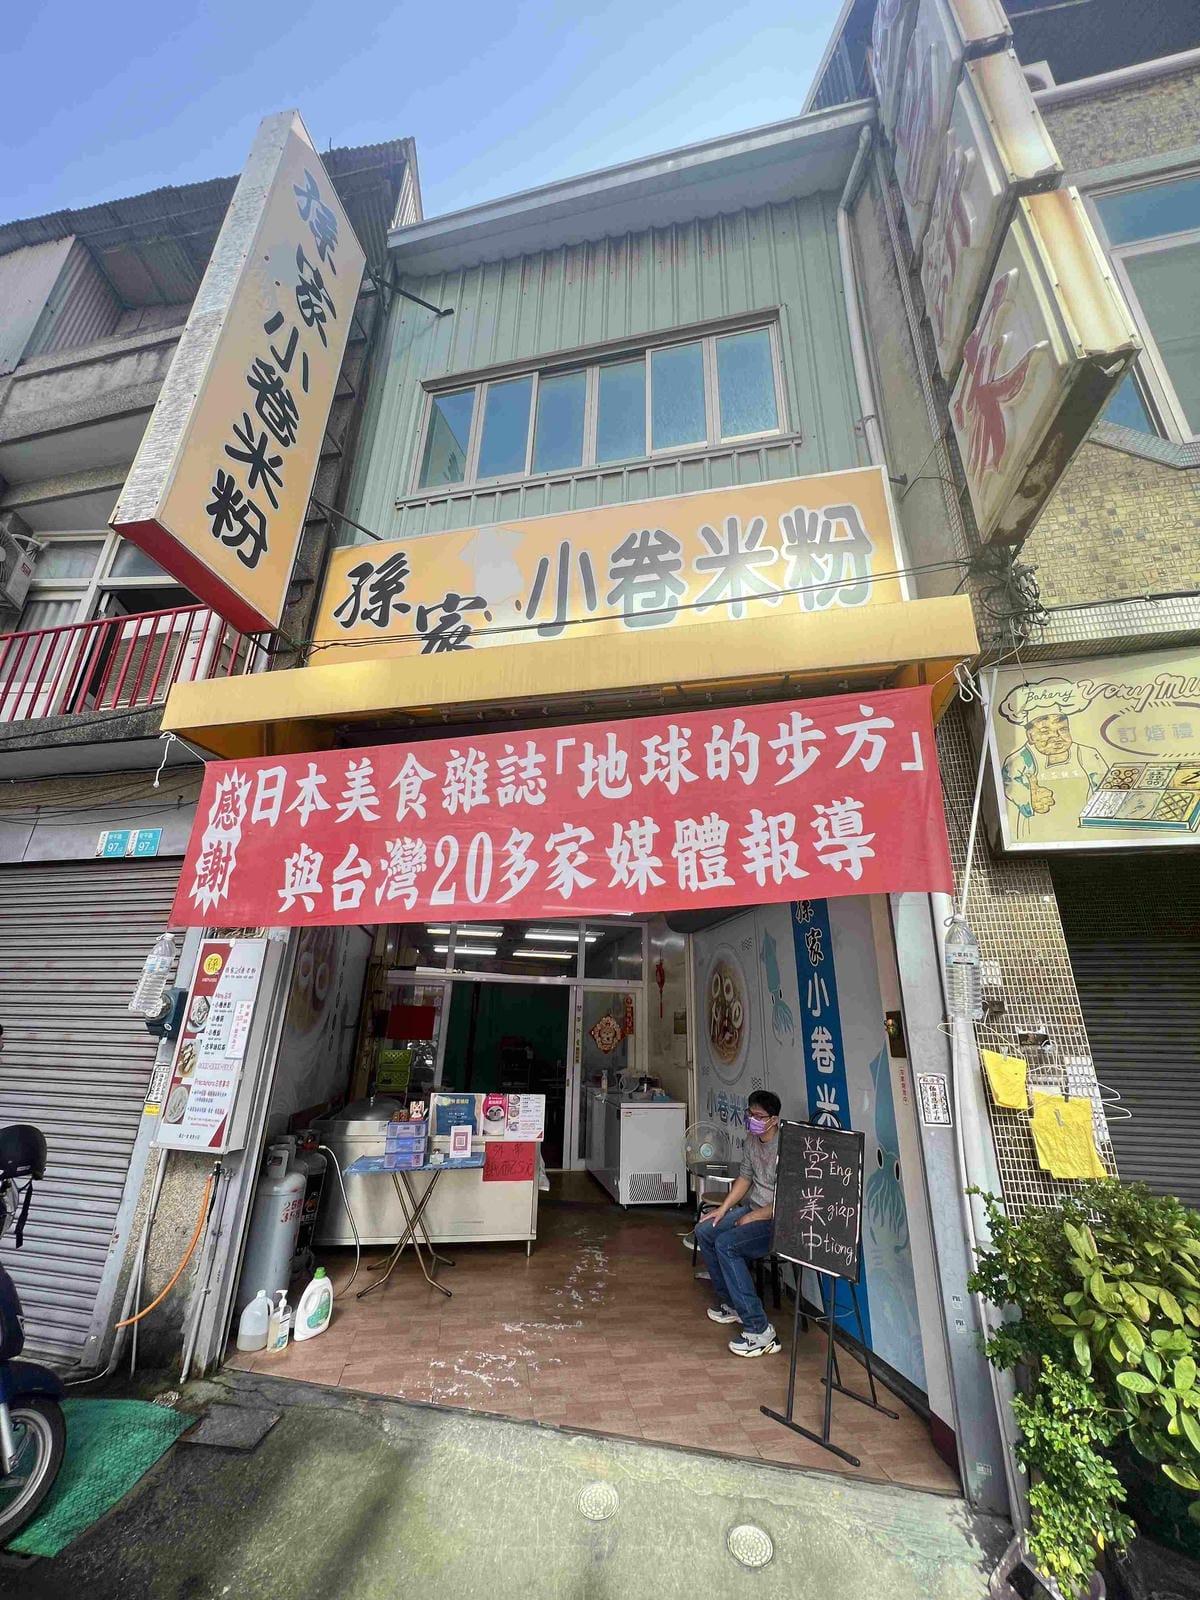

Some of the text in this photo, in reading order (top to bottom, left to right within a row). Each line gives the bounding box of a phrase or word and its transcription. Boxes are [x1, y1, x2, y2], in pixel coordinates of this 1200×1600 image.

[205, 168, 339, 570] 孫家小卷米粉
[197, 780, 243, 894] 感謝
[277, 797, 877, 914] 與台灣20多家媒體報導
